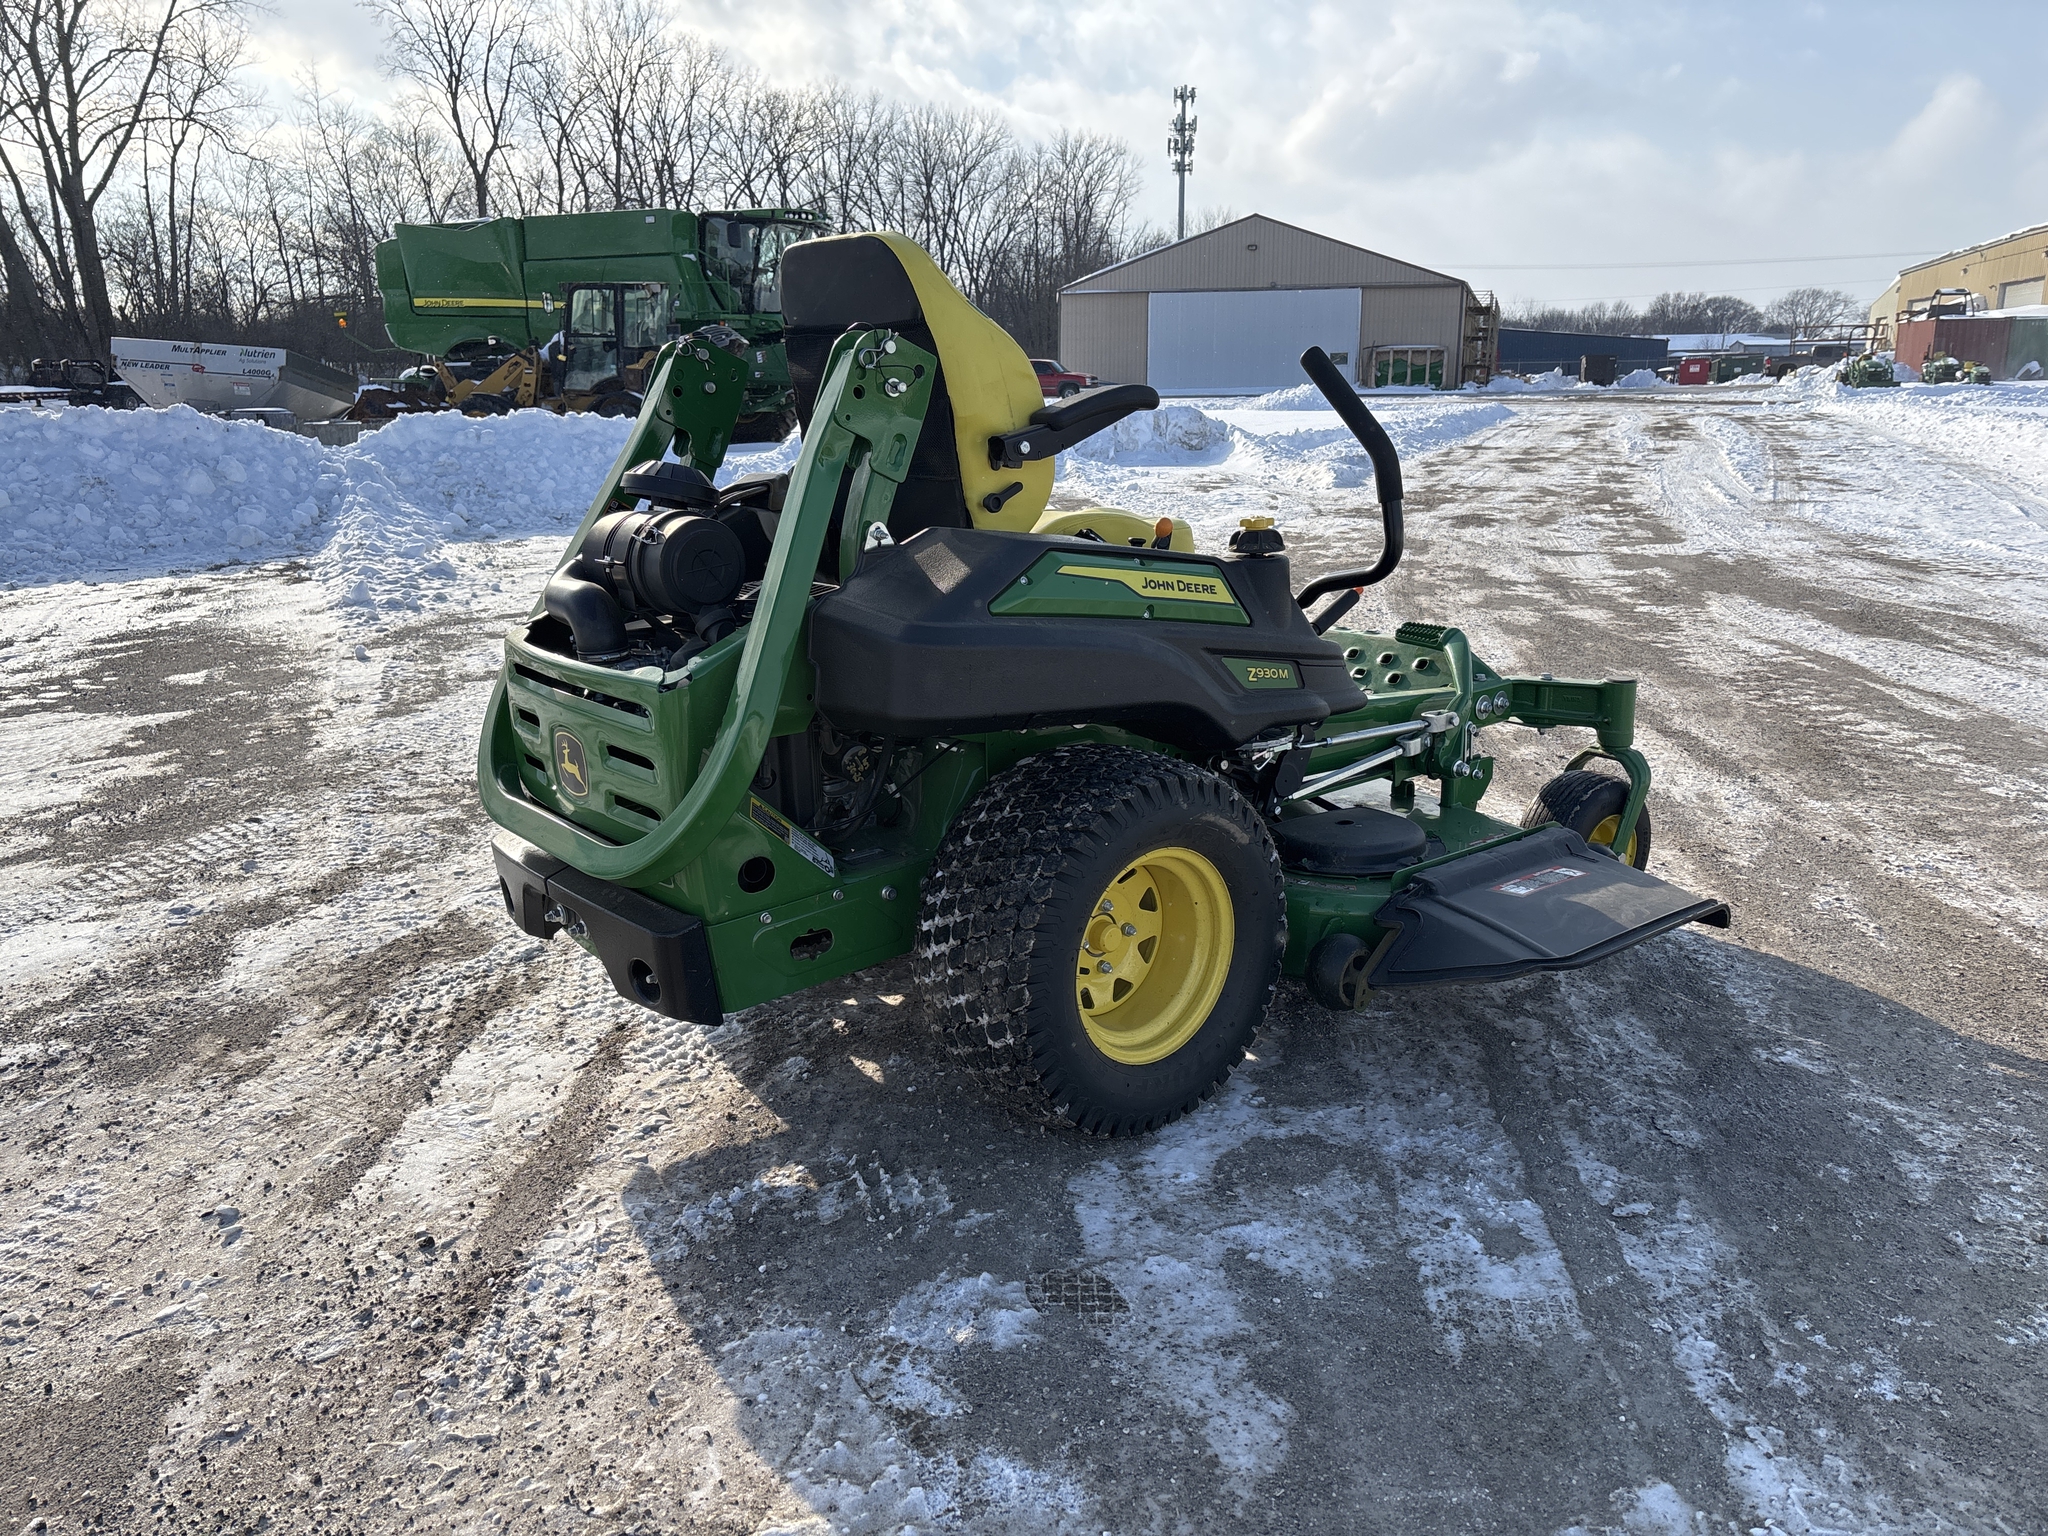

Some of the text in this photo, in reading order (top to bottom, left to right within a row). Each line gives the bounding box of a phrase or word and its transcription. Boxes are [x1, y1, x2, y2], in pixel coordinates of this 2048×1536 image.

[240, 348, 276, 359] Nutrien
[140, 362, 170, 370] LEADER
[1142, 577, 1217, 595] JOHN DEERE
[1246, 667, 1289, 682] Z930M
